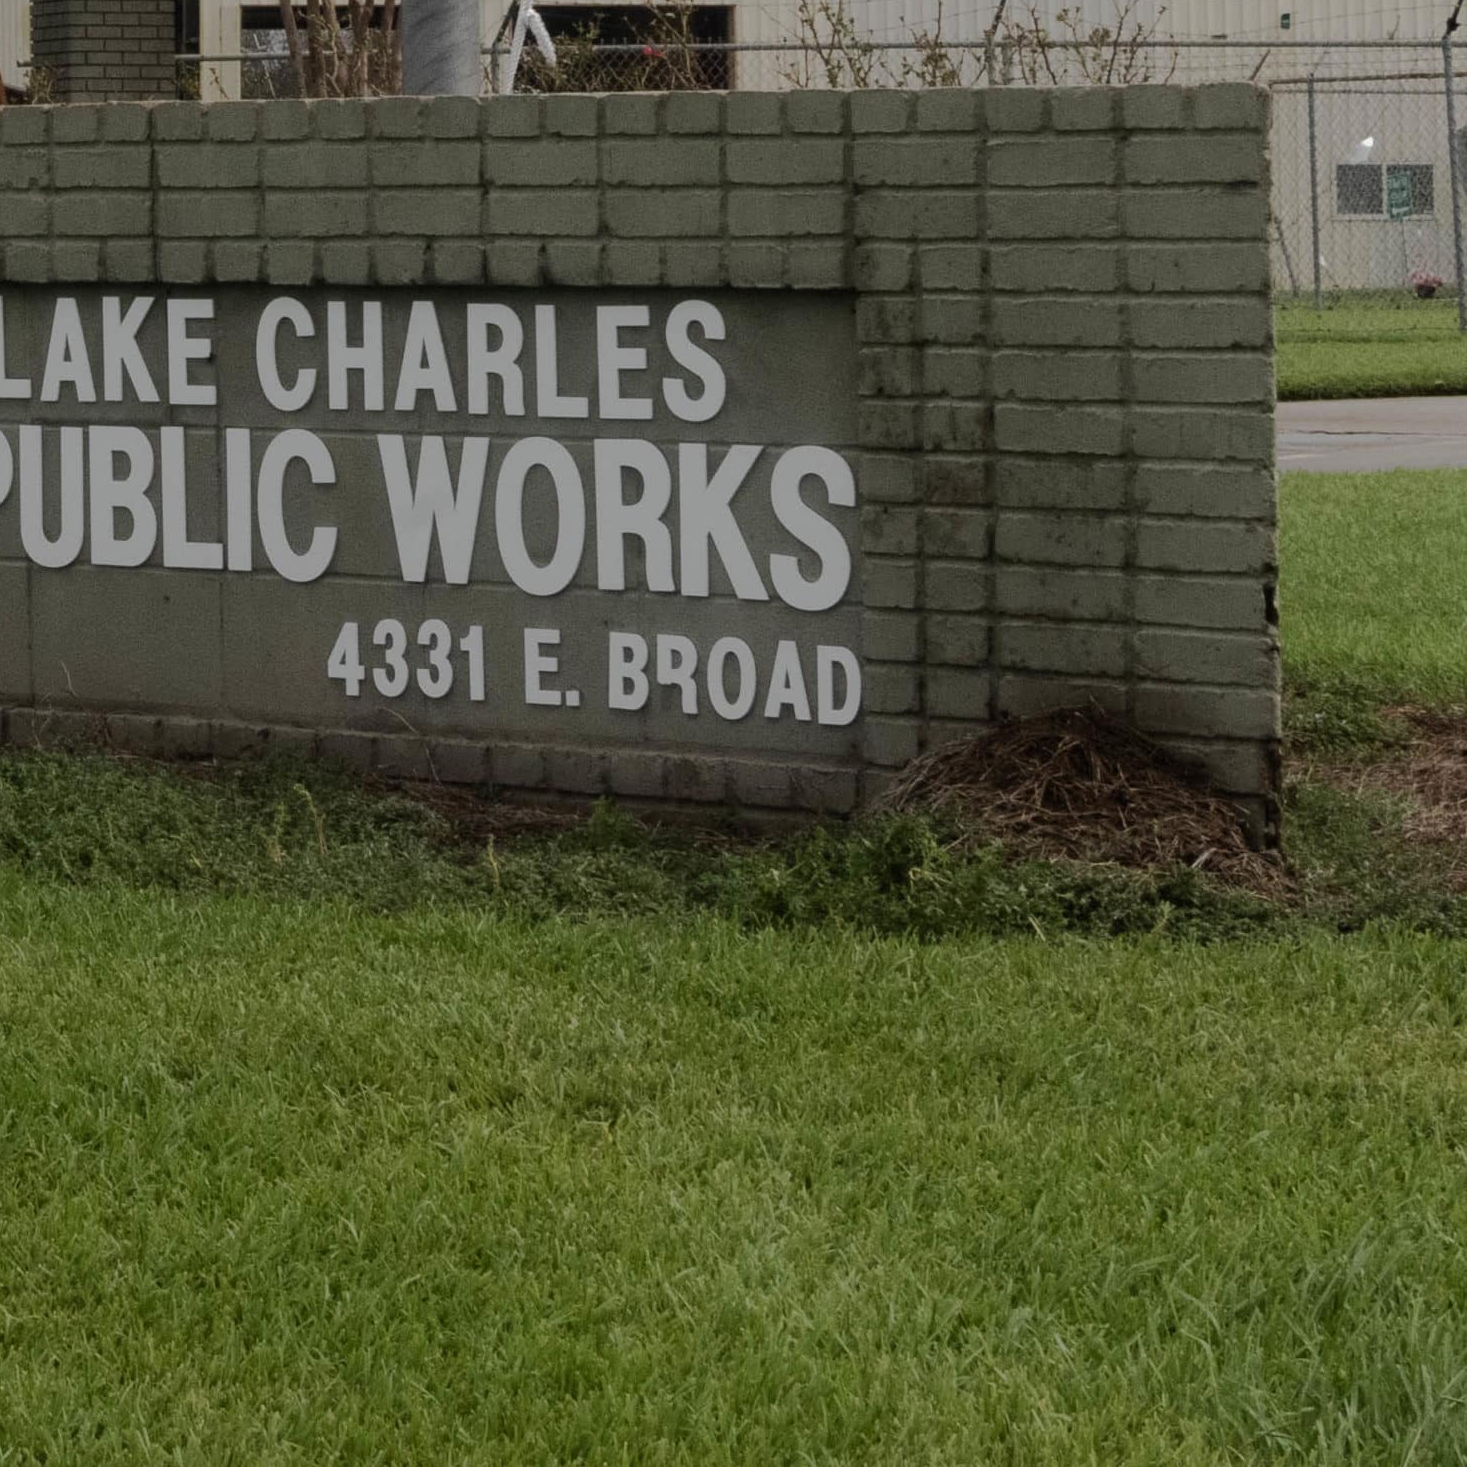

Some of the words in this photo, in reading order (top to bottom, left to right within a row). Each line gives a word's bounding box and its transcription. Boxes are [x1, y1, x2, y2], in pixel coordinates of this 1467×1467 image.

[255, 296, 726, 422] CHARLES
[376, 433, 856, 611] WORKS
[327, 618, 485, 701] 4331
[523, 627, 580, 707] E.
[608, 630, 862, 726] BROAD
